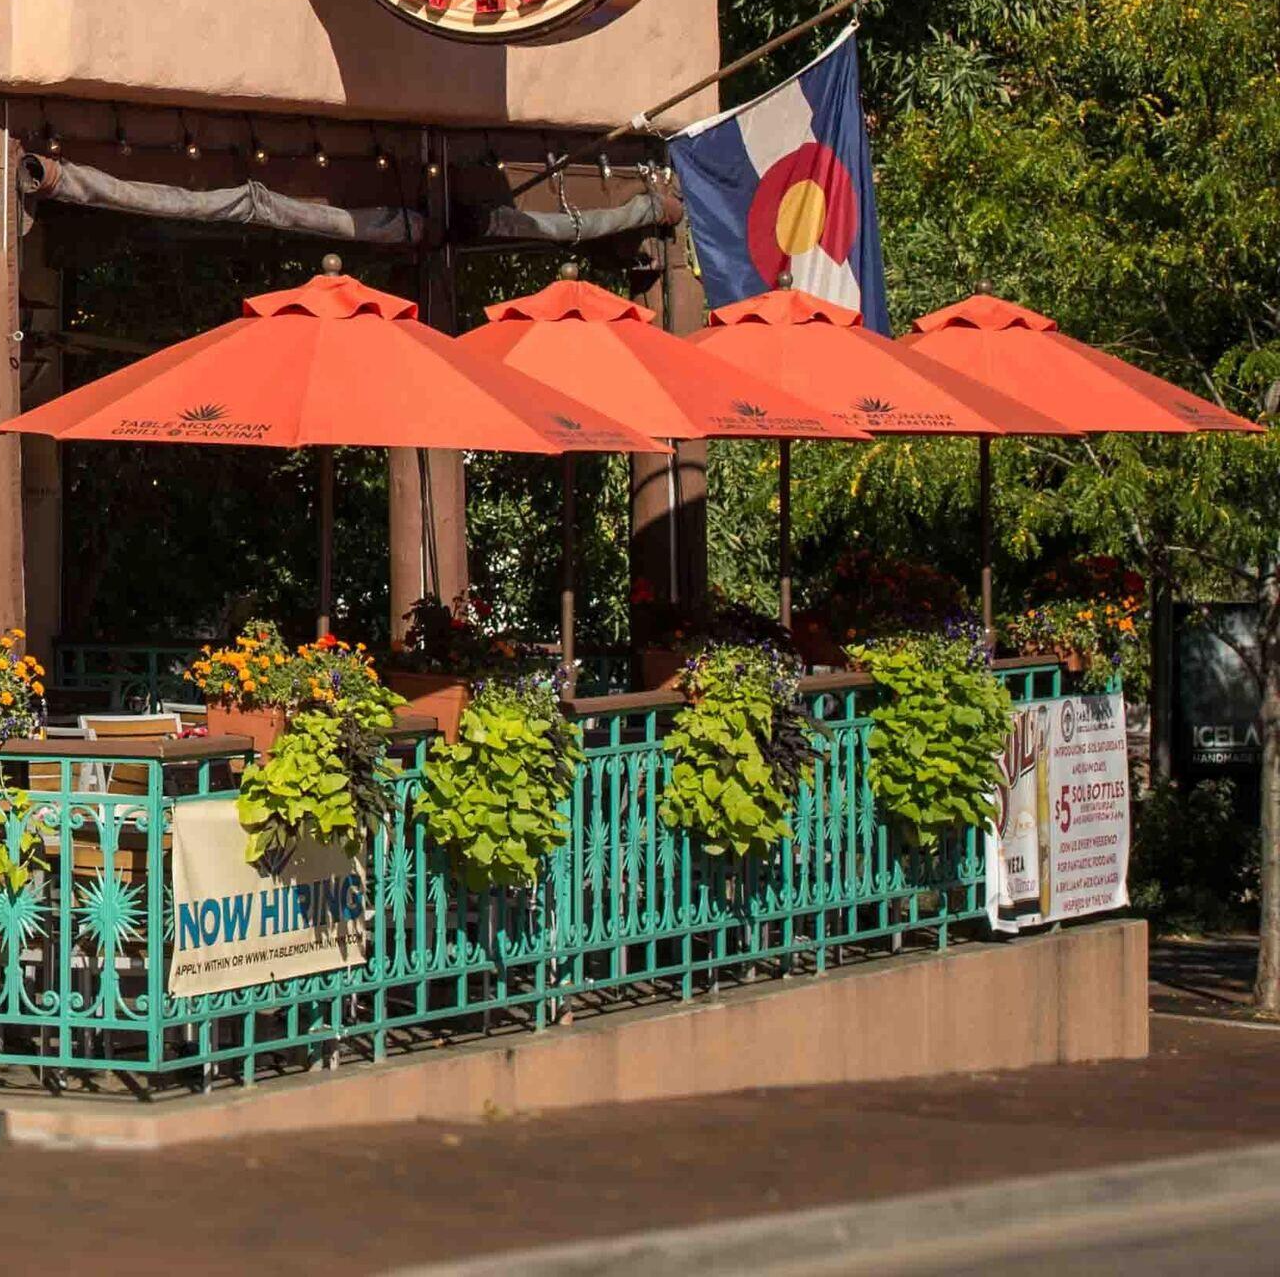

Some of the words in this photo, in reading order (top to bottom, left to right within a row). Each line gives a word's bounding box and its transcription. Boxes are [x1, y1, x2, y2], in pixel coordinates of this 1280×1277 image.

[111, 428, 161, 436] GRILL
[185, 430, 264, 440] CANTINA
[120, 419, 172, 429] TABLE
[178, 421, 272, 432] MOUNTAIN
[1087, 780, 1125, 800] BOTTLES
[178, 892, 253, 951] NOW
[259, 873, 364, 937] HIRING
[175, 963, 203, 977] APPLY
[204, 957, 231, 973] WITHIN
[232, 955, 244, 966] OR
